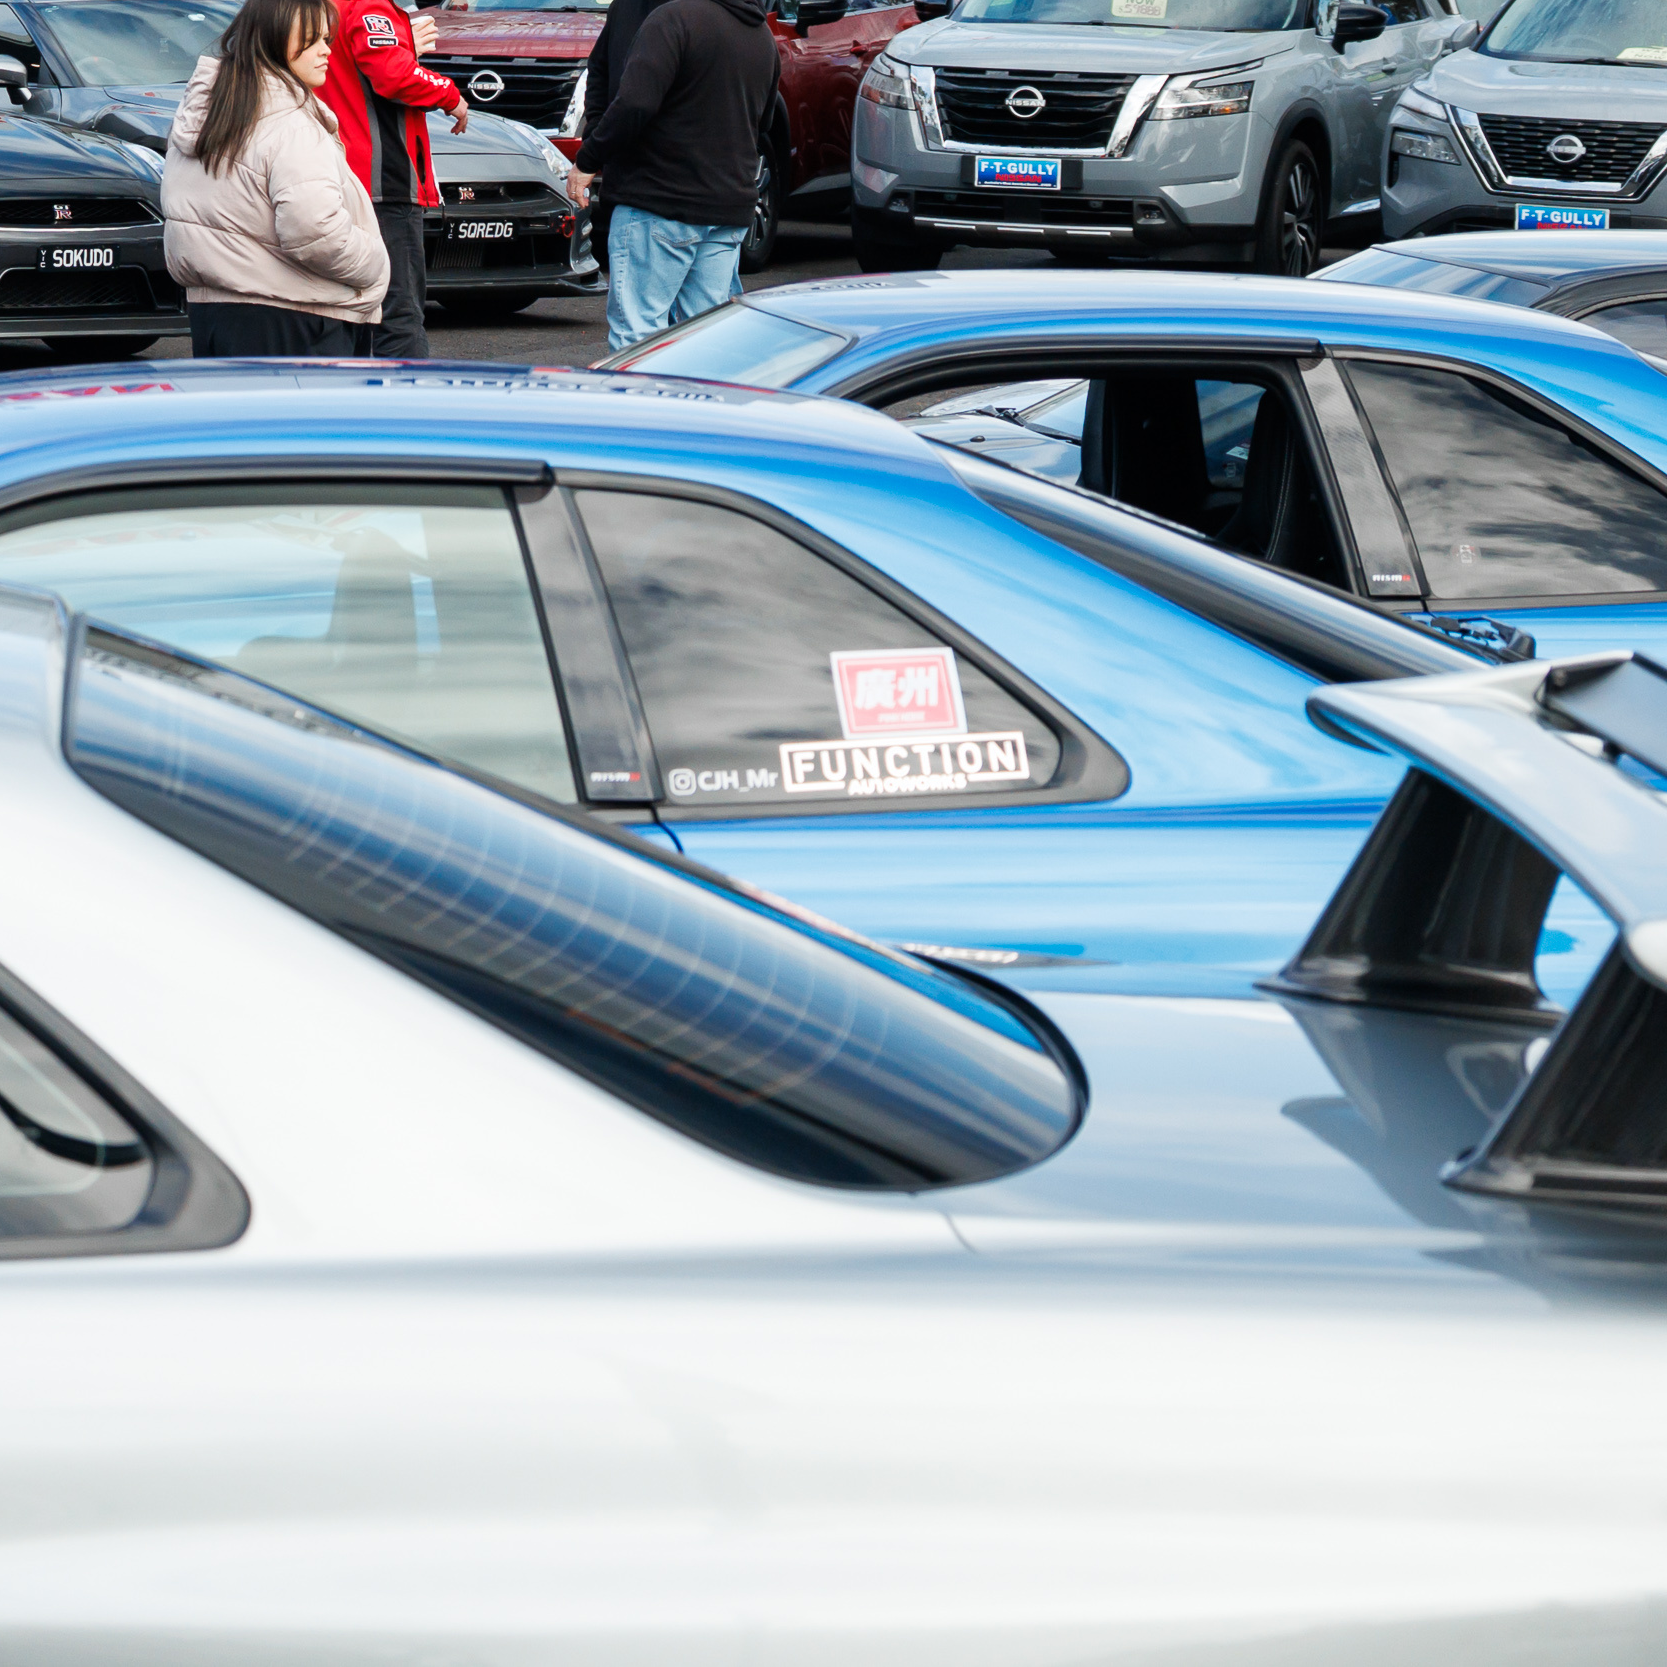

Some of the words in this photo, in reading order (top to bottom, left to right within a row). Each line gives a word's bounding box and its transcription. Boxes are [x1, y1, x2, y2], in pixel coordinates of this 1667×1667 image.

[467, 83, 504, 91] NISSAN
[1005, 98, 1046, 107] NISSAN
[980, 161, 1056, 176] F-T-GULLY
[995, 173, 1042, 183] NISSAN
[1521, 209, 1603, 226] F-T-GULLY
[458, 222, 513, 239] SQREDG
[1537, 222, 1588, 230] NISS
[52, 248, 113, 267] SOKUDO
[794, 740, 1018, 784] FUNCTION
[698, 769, 778, 792] CJH_Mr
